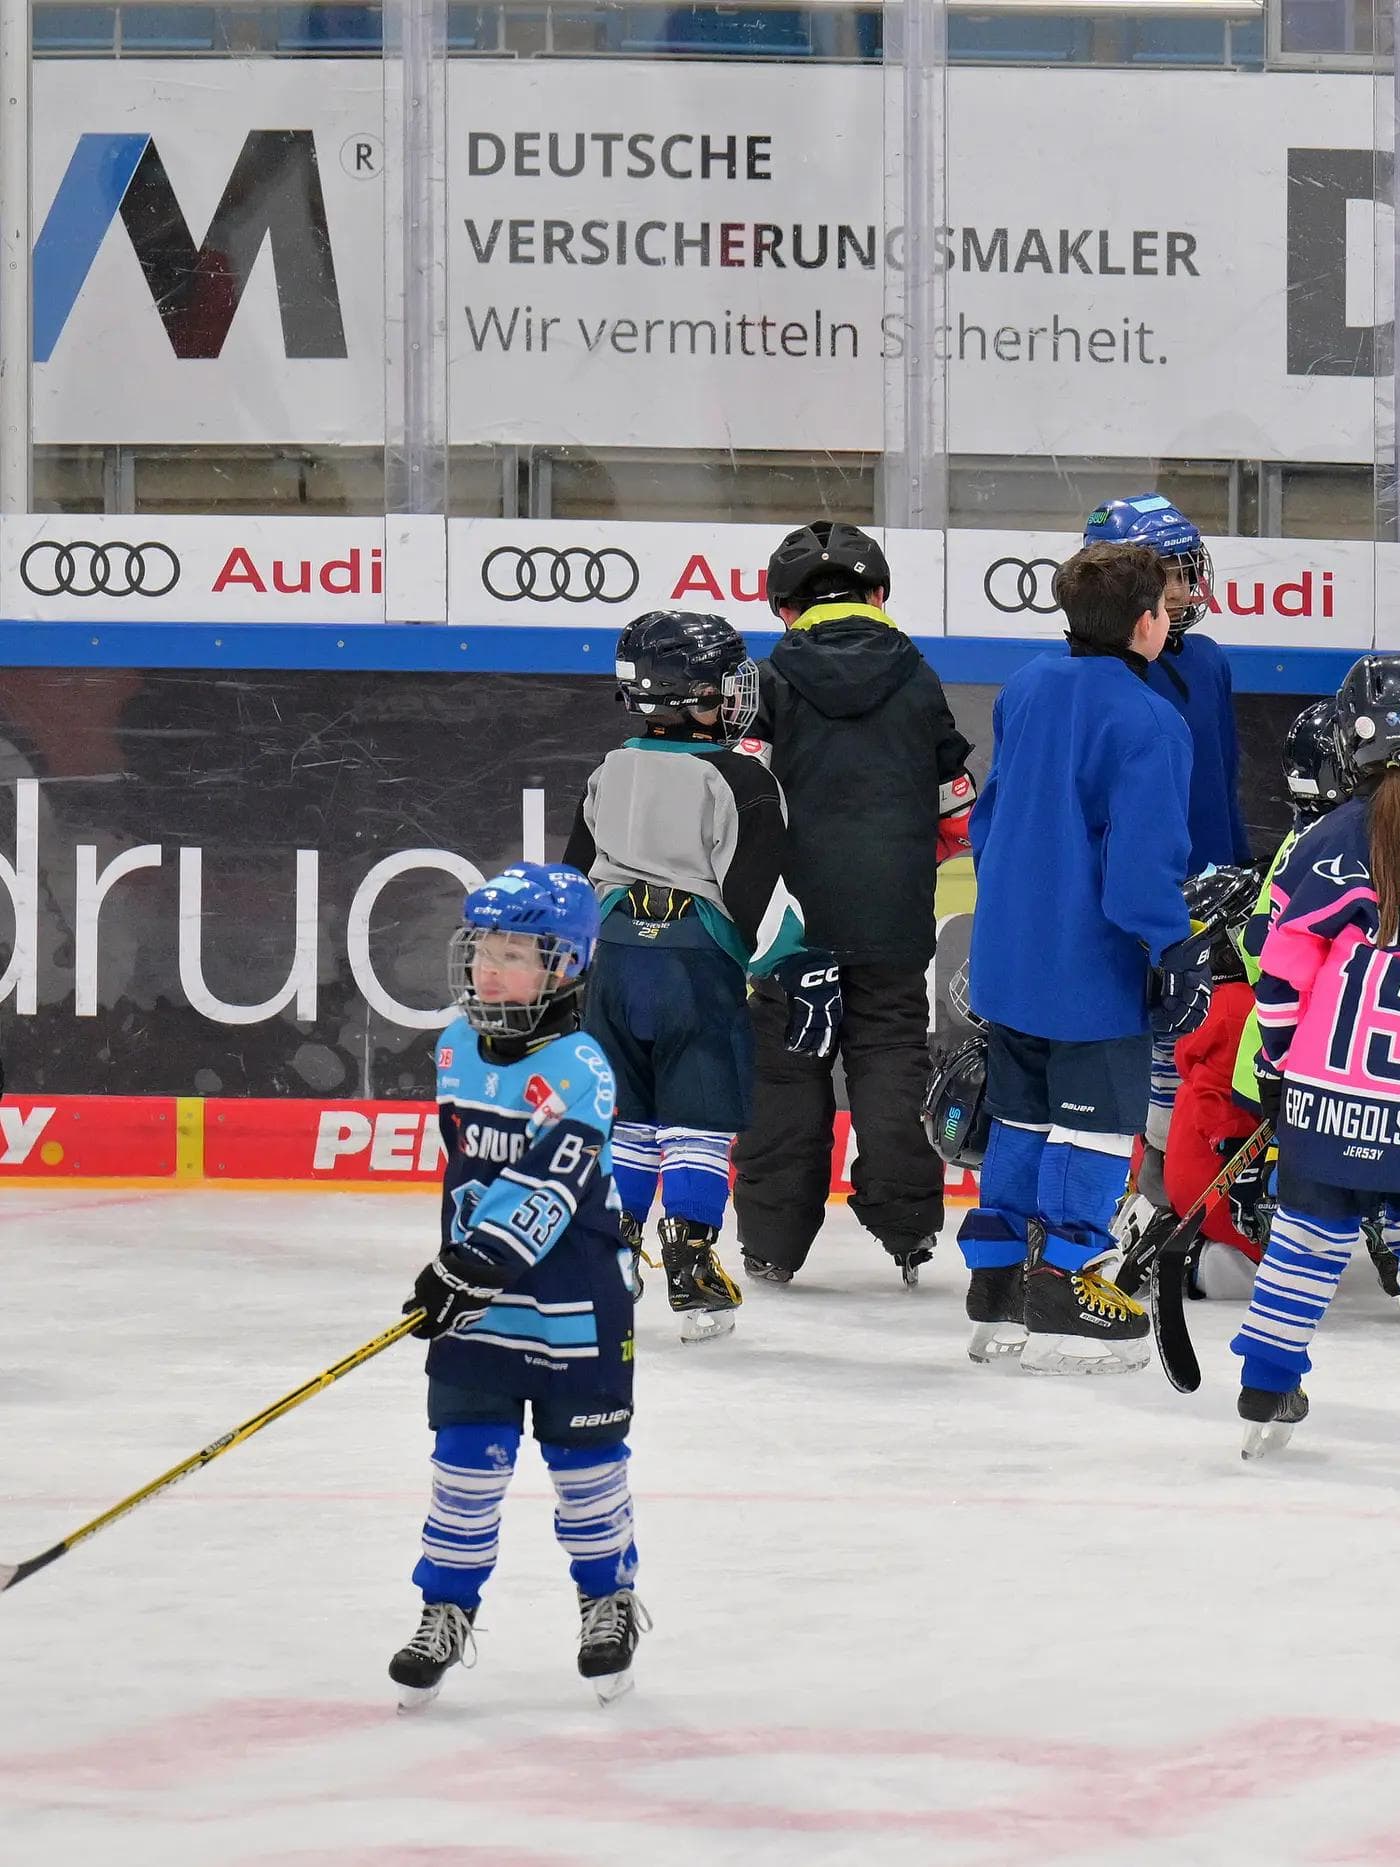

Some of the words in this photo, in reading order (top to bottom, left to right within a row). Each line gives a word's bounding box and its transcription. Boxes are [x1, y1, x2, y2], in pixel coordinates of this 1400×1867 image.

[468, 131, 773, 181] DEUTSCHE
[465, 305, 552, 352] Wir
[577, 307, 859, 360] vermitteln
[881, 312, 1168, 365] Scherheit.
[211, 548, 382, 593] Audi
[1060, 1101, 1096, 1114] BAUER
[1286, 1087, 1314, 1130] ERC
[1342, 1144, 1385, 1161] JER53Y
[510, 1192, 564, 1248] 53
